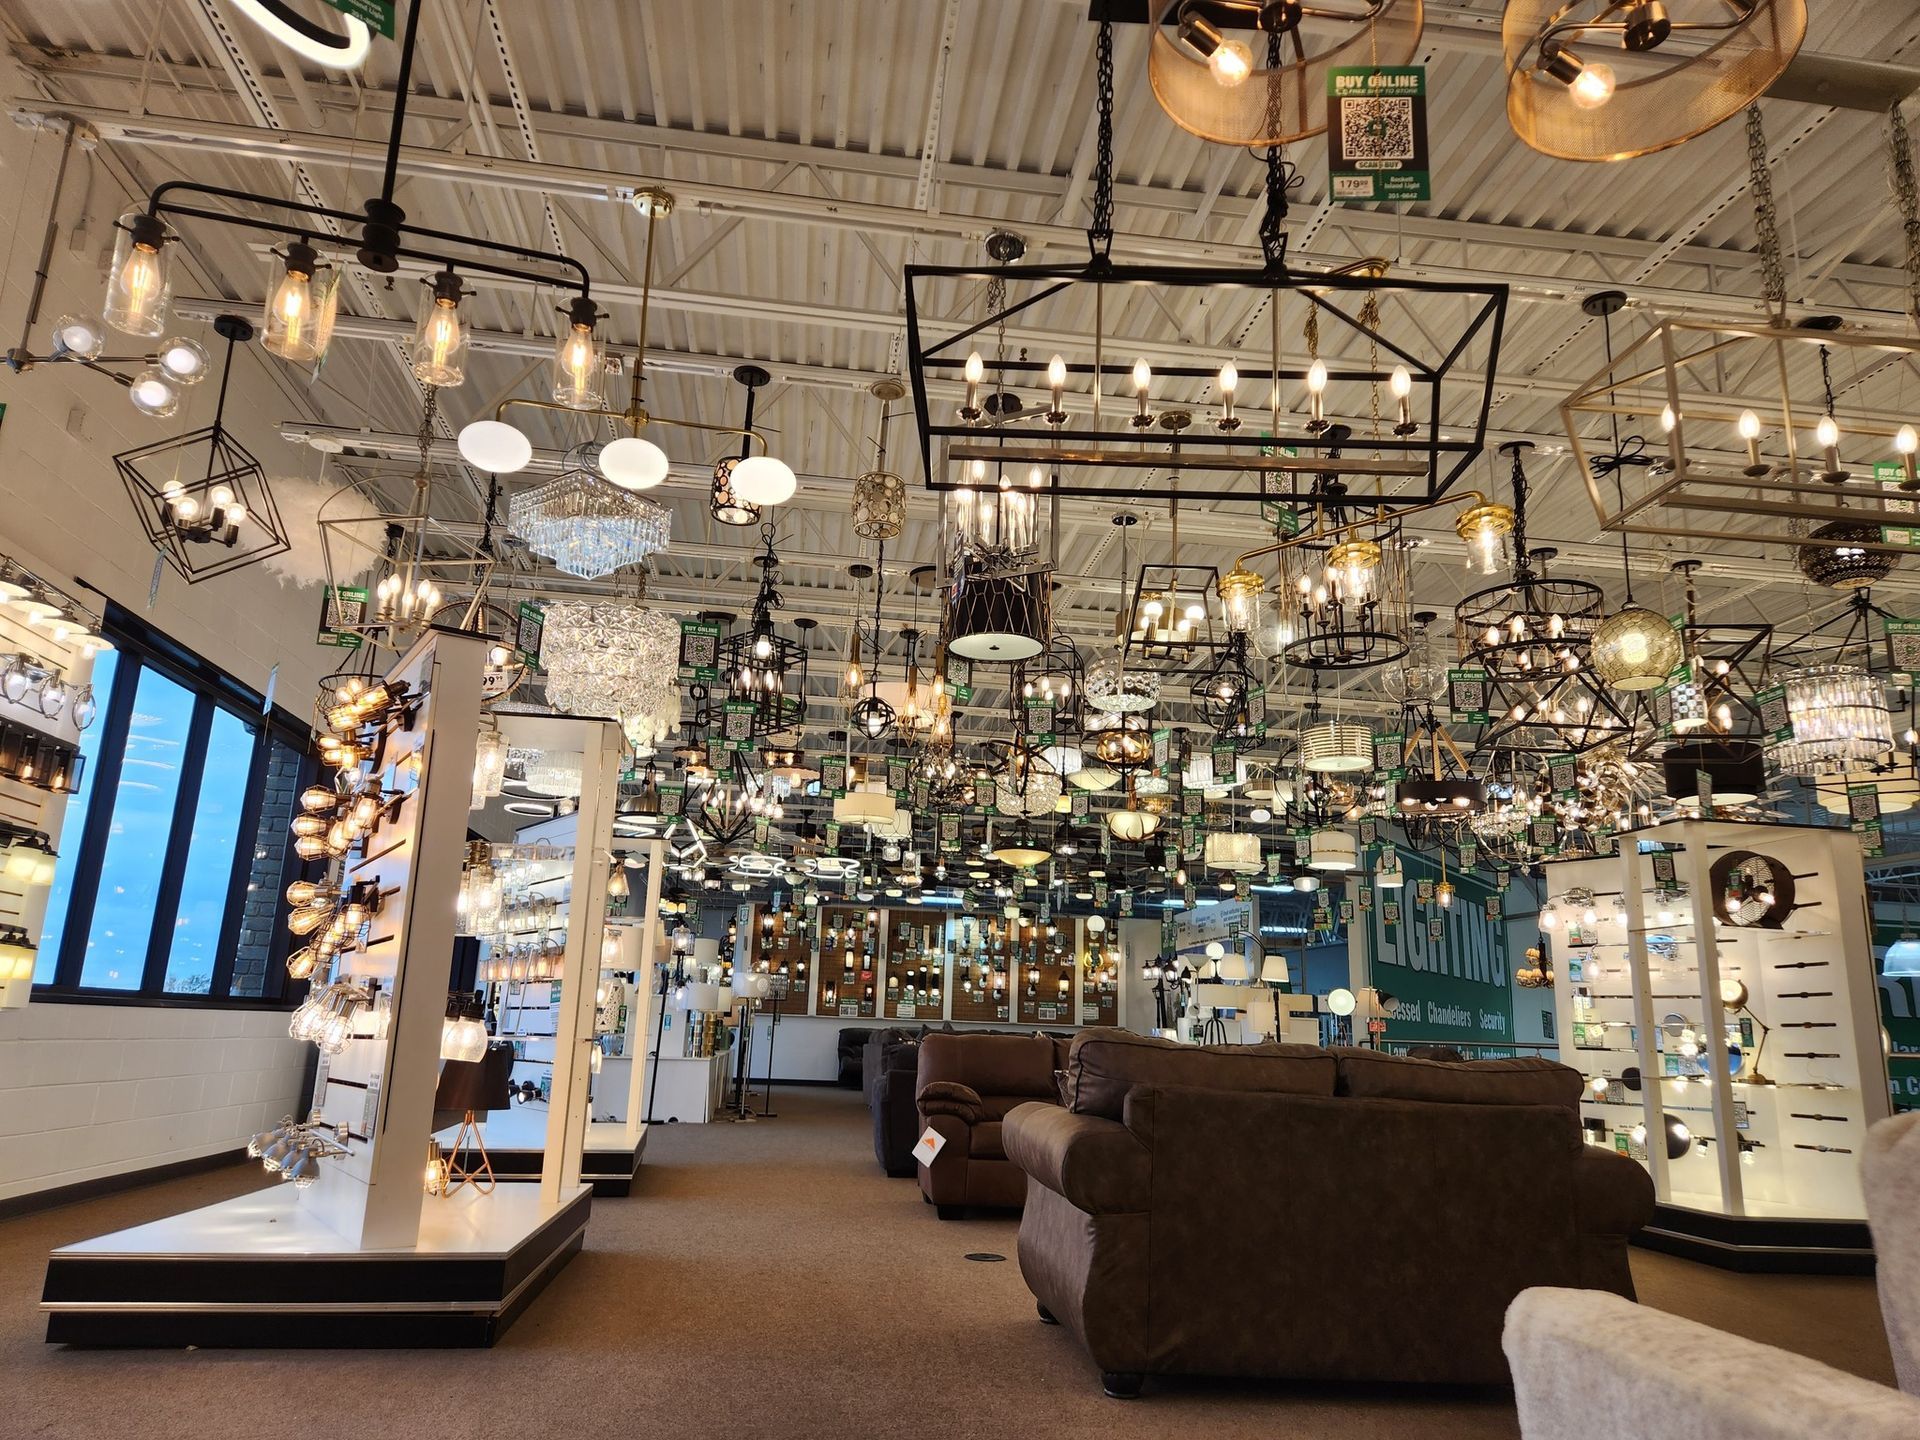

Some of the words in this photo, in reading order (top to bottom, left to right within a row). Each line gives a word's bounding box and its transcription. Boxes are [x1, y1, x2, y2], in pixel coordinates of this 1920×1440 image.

[1336, 75, 1364, 88] BUY
[1368, 75, 1418, 87] ONLINE
[1374, 876, 1505, 987] LIGHTING
[1428, 1001, 1472, 1028] Chandeliers
[1480, 1008, 1505, 1034] Security
